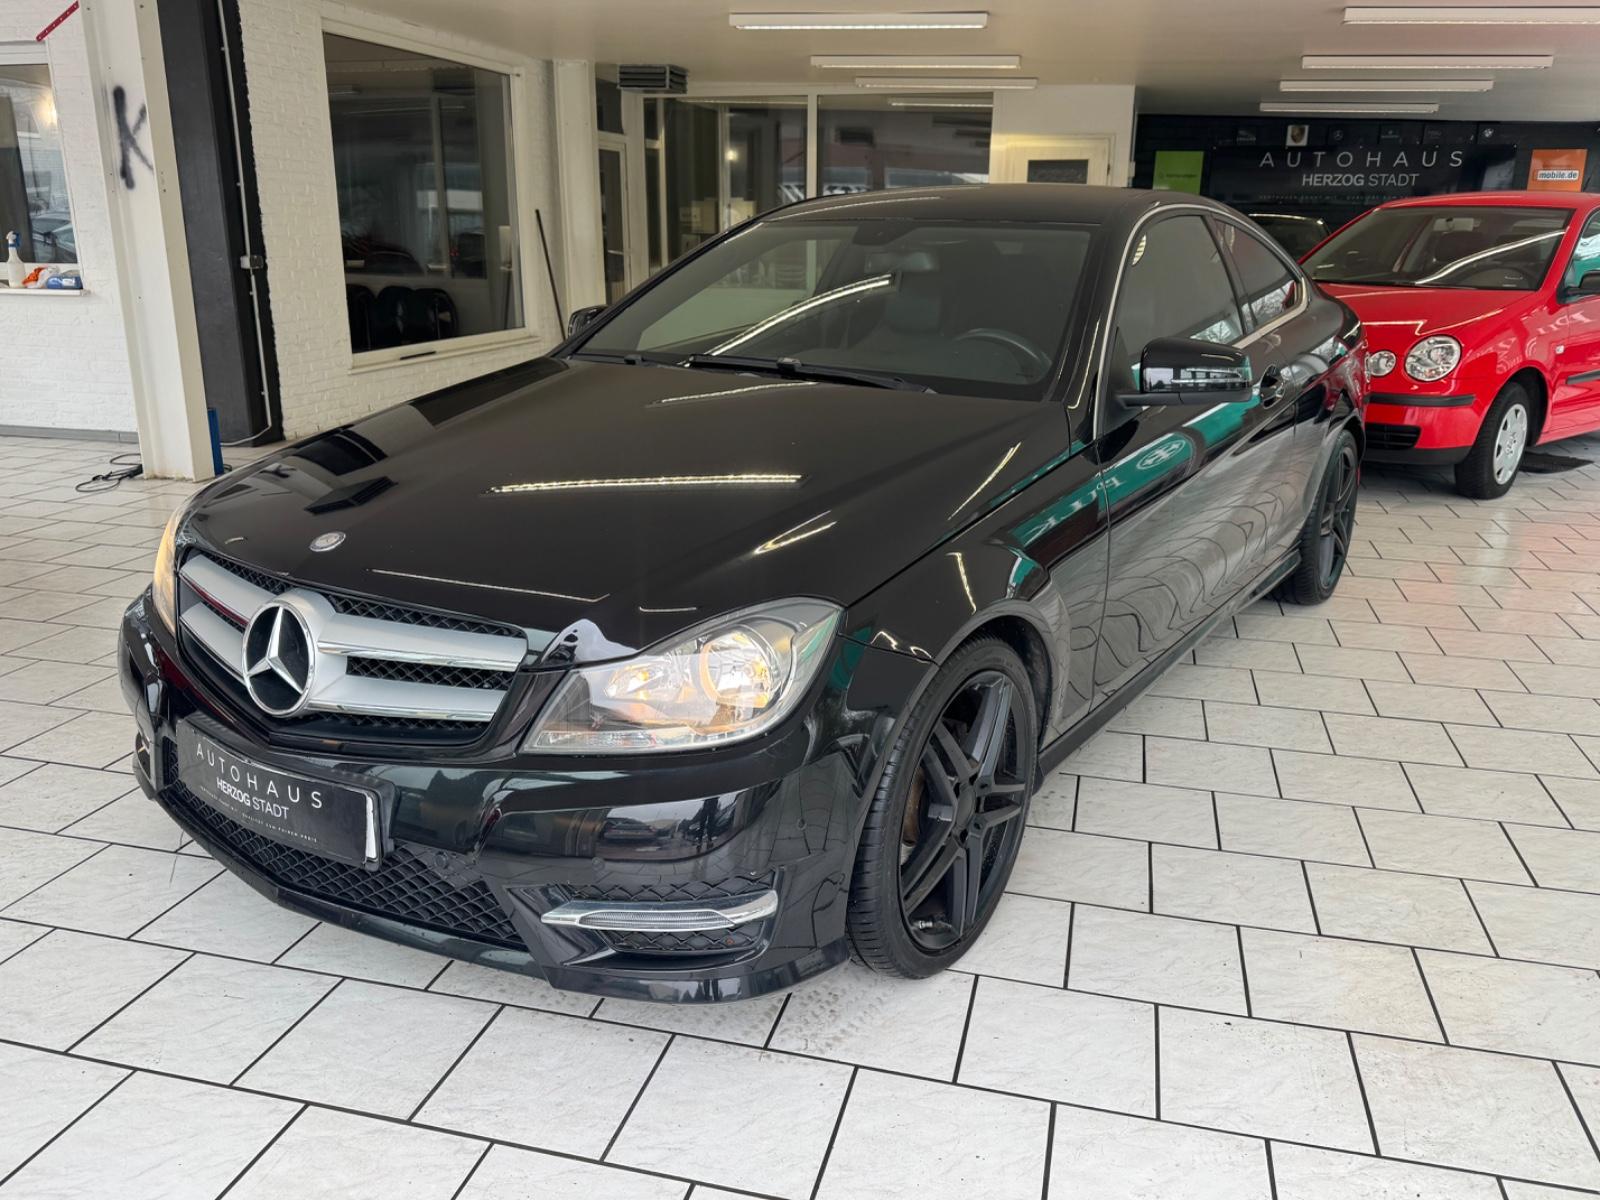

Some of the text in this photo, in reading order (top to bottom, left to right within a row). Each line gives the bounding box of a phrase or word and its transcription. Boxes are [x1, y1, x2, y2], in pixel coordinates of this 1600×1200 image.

[1259, 151, 1464, 168] AUTOHAUS
[1301, 173, 1420, 187] HERZOG STADT
[1538, 171, 1578, 180] mobile.de
[196, 743, 323, 809] AUTOHAUS
[216, 776, 251, 807] HERZOG
[252, 796, 290, 820] STADT
